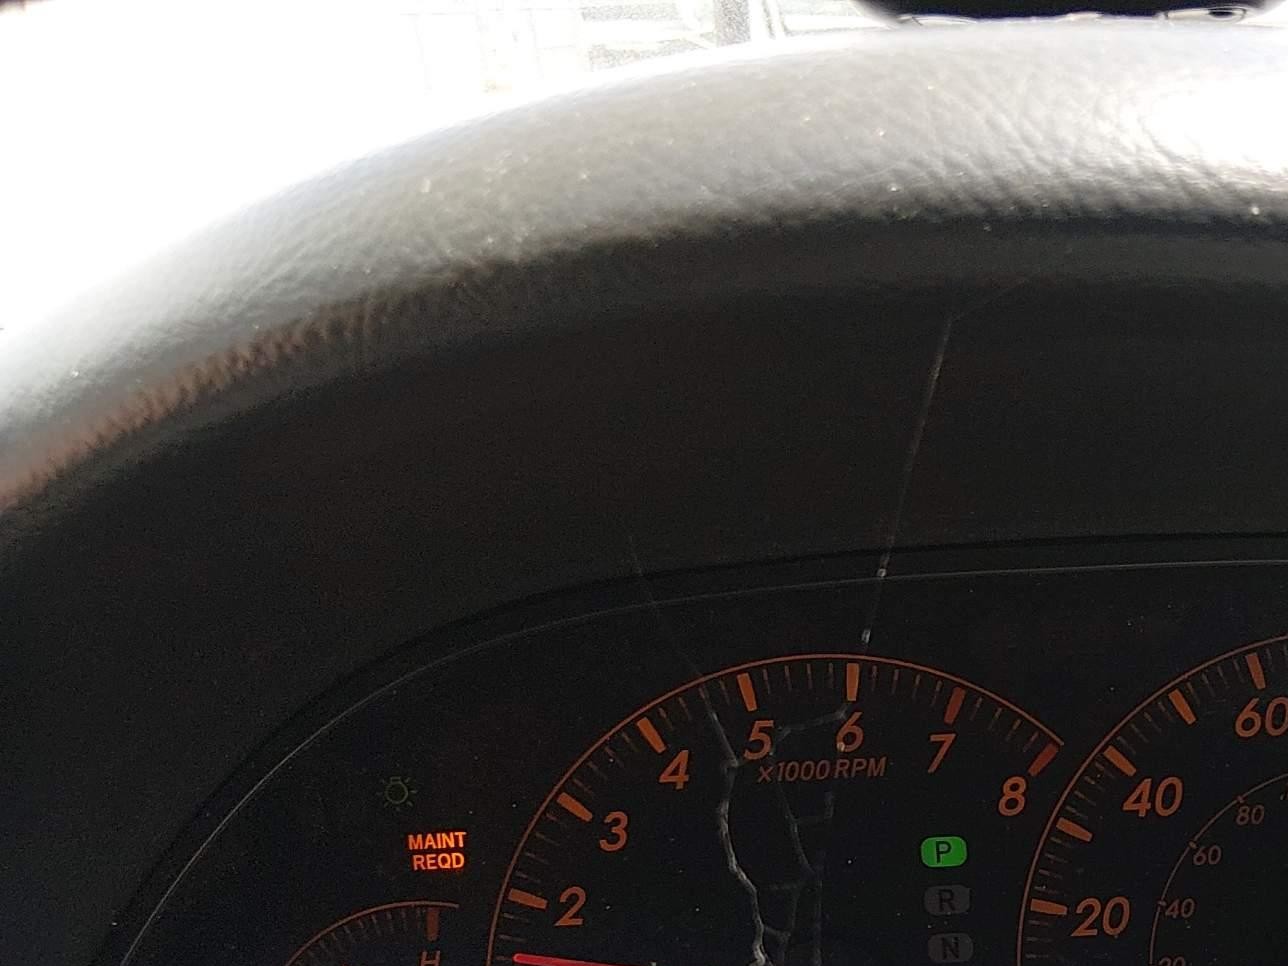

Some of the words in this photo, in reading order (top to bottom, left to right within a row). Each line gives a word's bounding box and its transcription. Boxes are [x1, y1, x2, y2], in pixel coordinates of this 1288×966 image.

[743, 720, 775, 759] 5
[836, 713, 864, 752] 6
[834, 756, 886, 779] RPM
[927, 734, 957, 773] 7
[658, 750, 690, 791] 4
[997, 775, 1028, 815] 8
[1124, 777, 1185, 817] 40
[1236, 805, 1264, 825] 80
[408, 831, 467, 851] MAINT
[599, 812, 630, 851] 3
[412, 850, 465, 870] REQD
[934, 841, 952, 862] P
[1193, 845, 1222, 866] 60
[555, 887, 587, 926] 2
[938, 889, 955, 911] R
[1165, 898, 1195, 919] 40
[1072, 897, 1131, 938] 20
[941, 937, 959, 959] N
